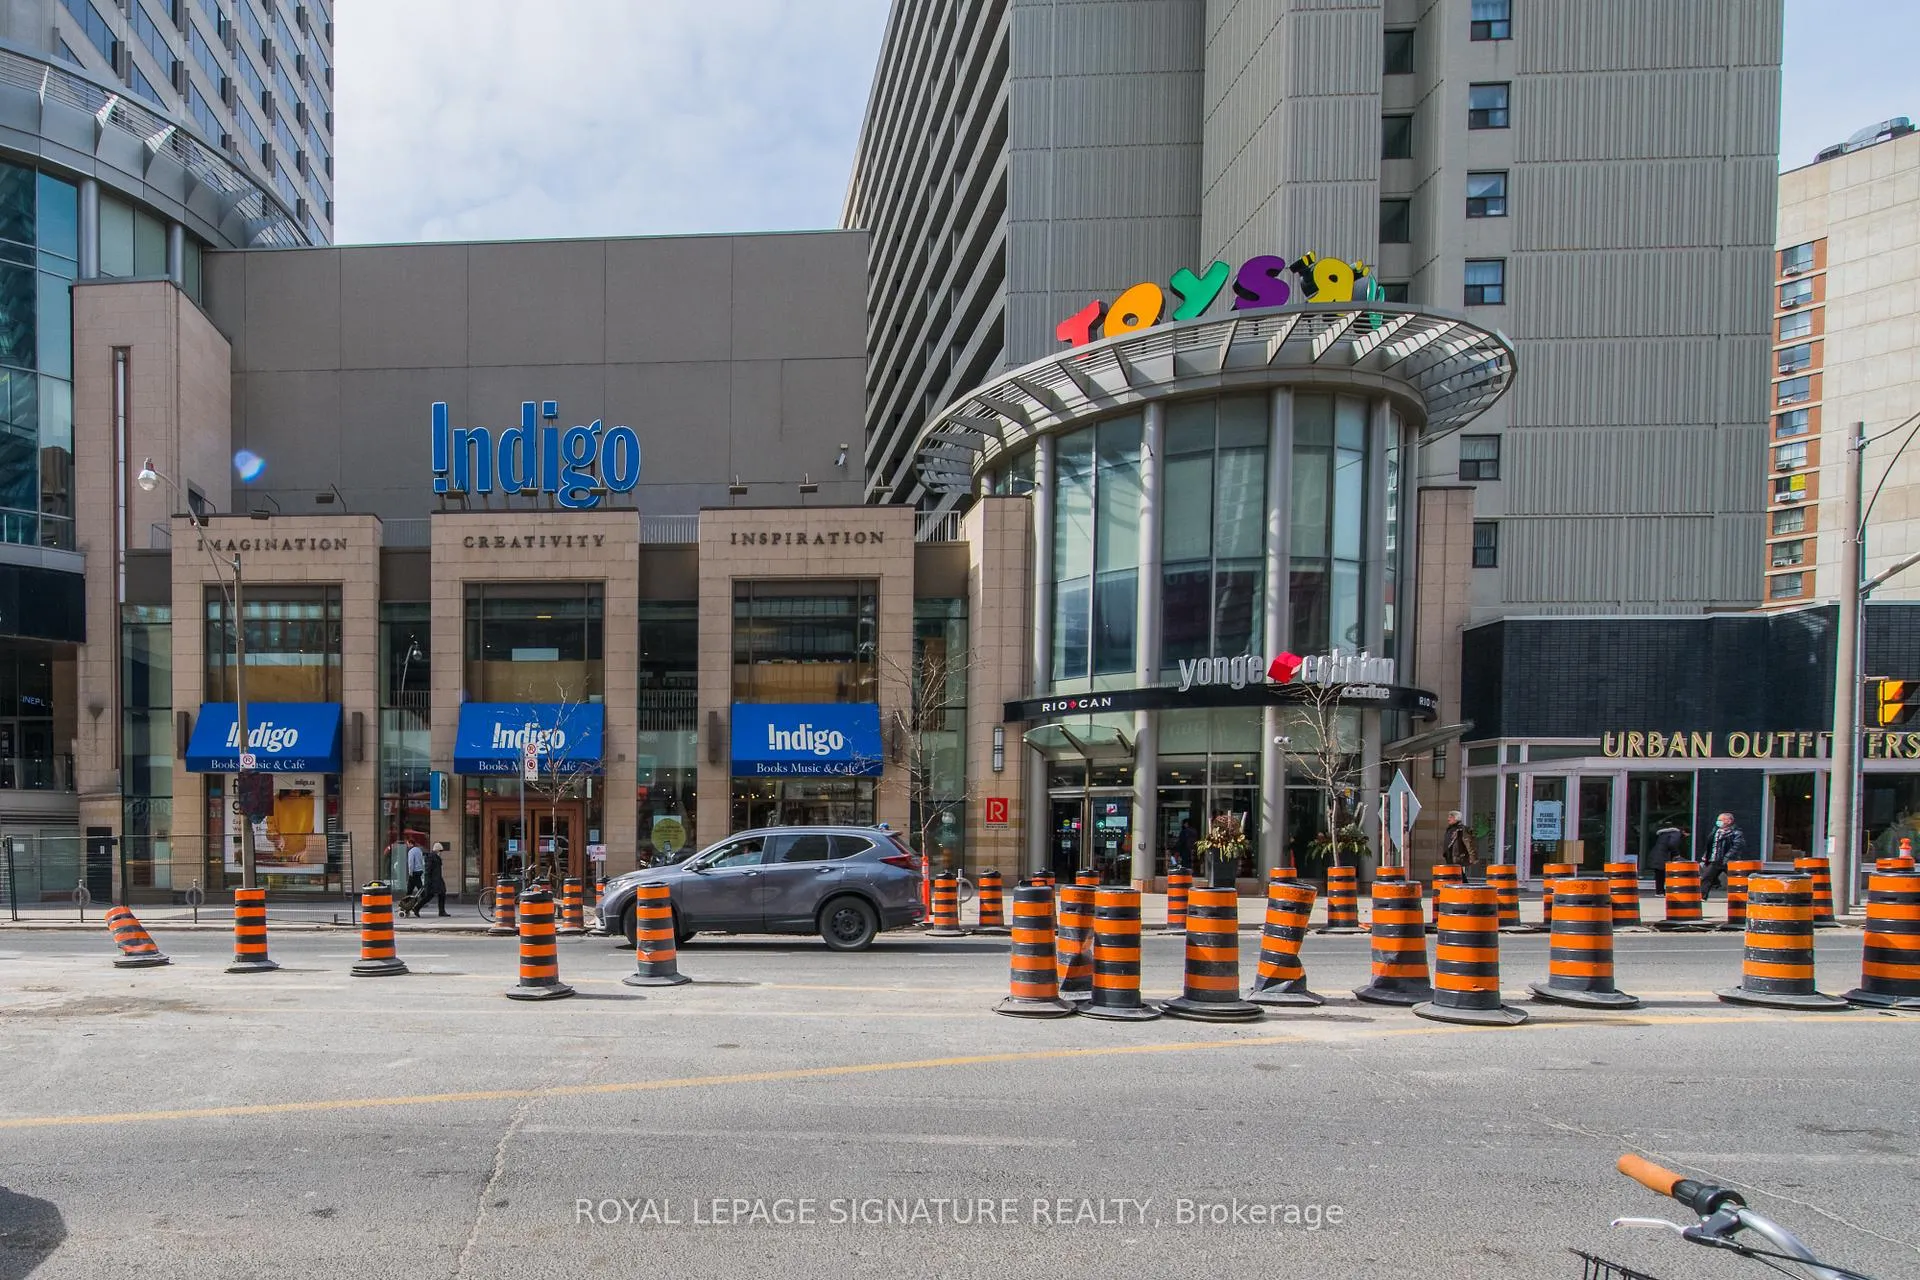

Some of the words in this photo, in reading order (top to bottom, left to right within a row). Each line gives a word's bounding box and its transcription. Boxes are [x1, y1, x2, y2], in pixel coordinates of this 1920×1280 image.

[197, 538, 348, 551] IMAGINATION
[463, 534, 604, 548] CREATIVITY
[730, 531, 884, 545] INSPIRATION
[1179, 654, 1264, 692] yonge
[1042, 701, 1068, 712] RIO
[1078, 697, 1111, 709] CAN
[1602, 731, 1713, 759] URBAN
[273, 760, 284, 771] &
[283, 758, 306, 770] Café
[478, 760, 509, 771] Books
[756, 763, 788, 773] Books
[791, 763, 821, 773] Music
[990, 801, 1004, 820] R
